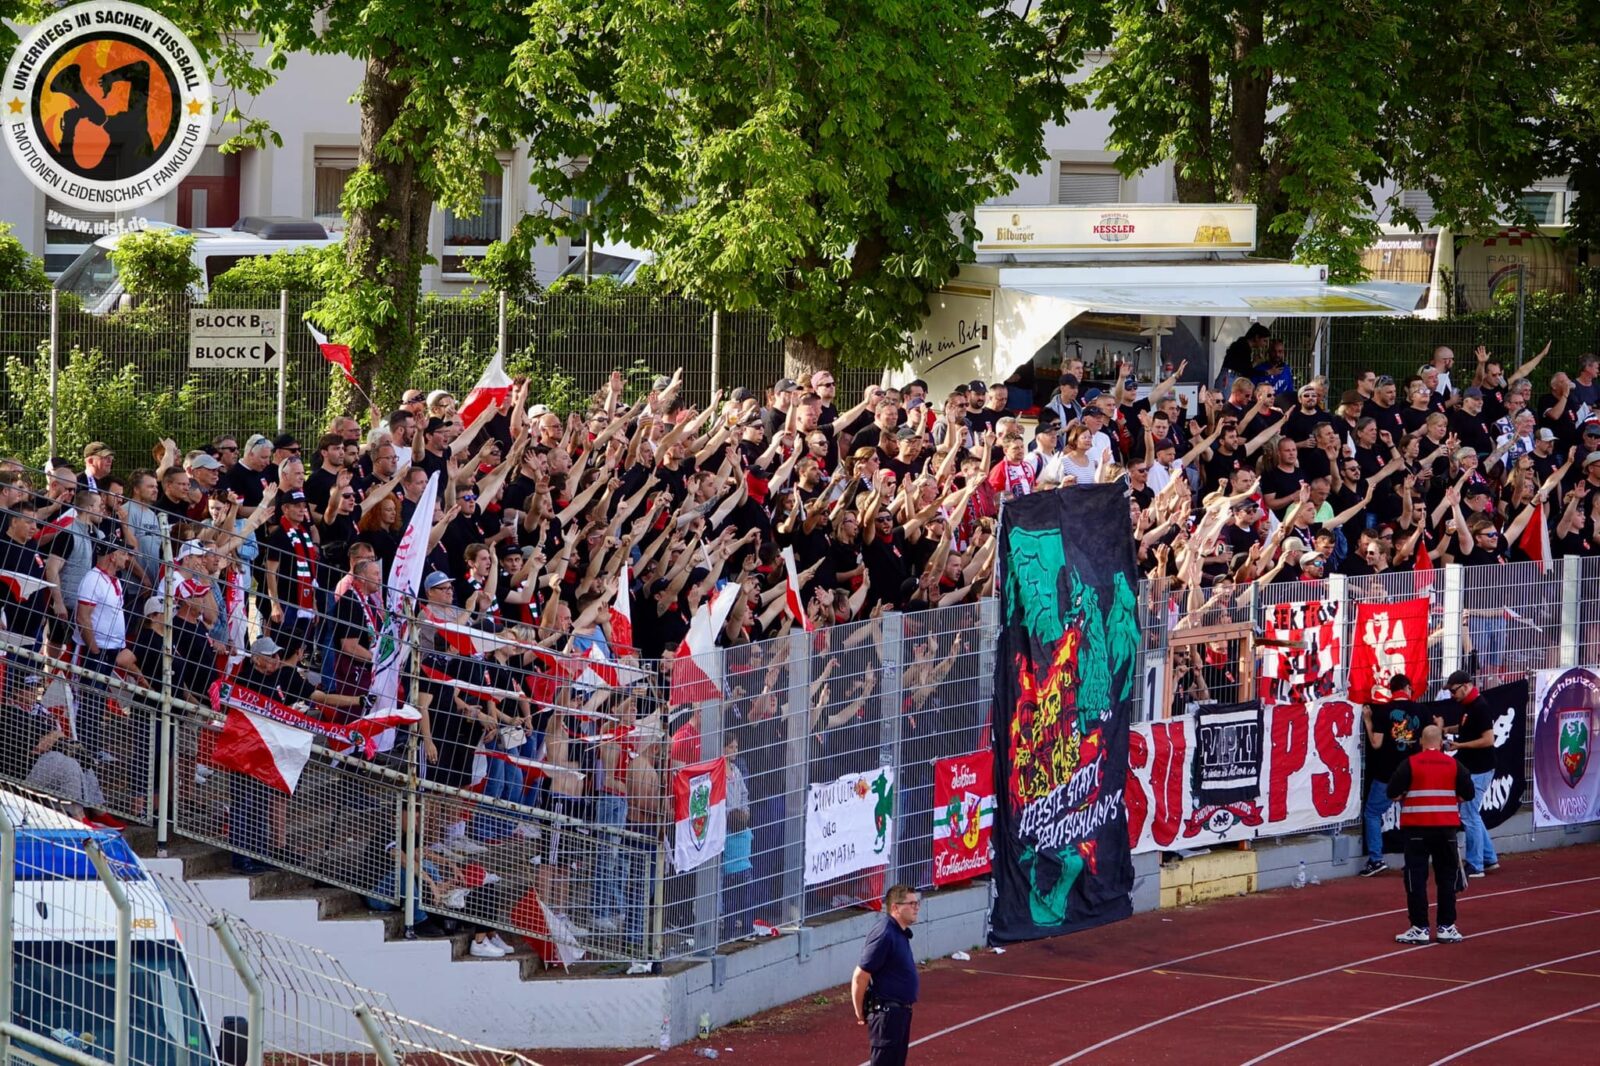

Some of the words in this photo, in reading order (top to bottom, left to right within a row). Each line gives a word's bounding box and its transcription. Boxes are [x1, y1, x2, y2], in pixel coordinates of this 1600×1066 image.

[1093, 224, 1136, 234] KESSLER
[195, 315, 247, 328] BLOCK
[250, 314, 260, 328] B
[937, 336, 955, 352] ein
[958, 319, 981, 345] Bit
[195, 346, 247, 359] BLOCK
[250, 346, 260, 359] C
[237, 688, 260, 706] VfR
[329, 724, 346, 737] 08
[1067, 753, 1103, 807] STADT
